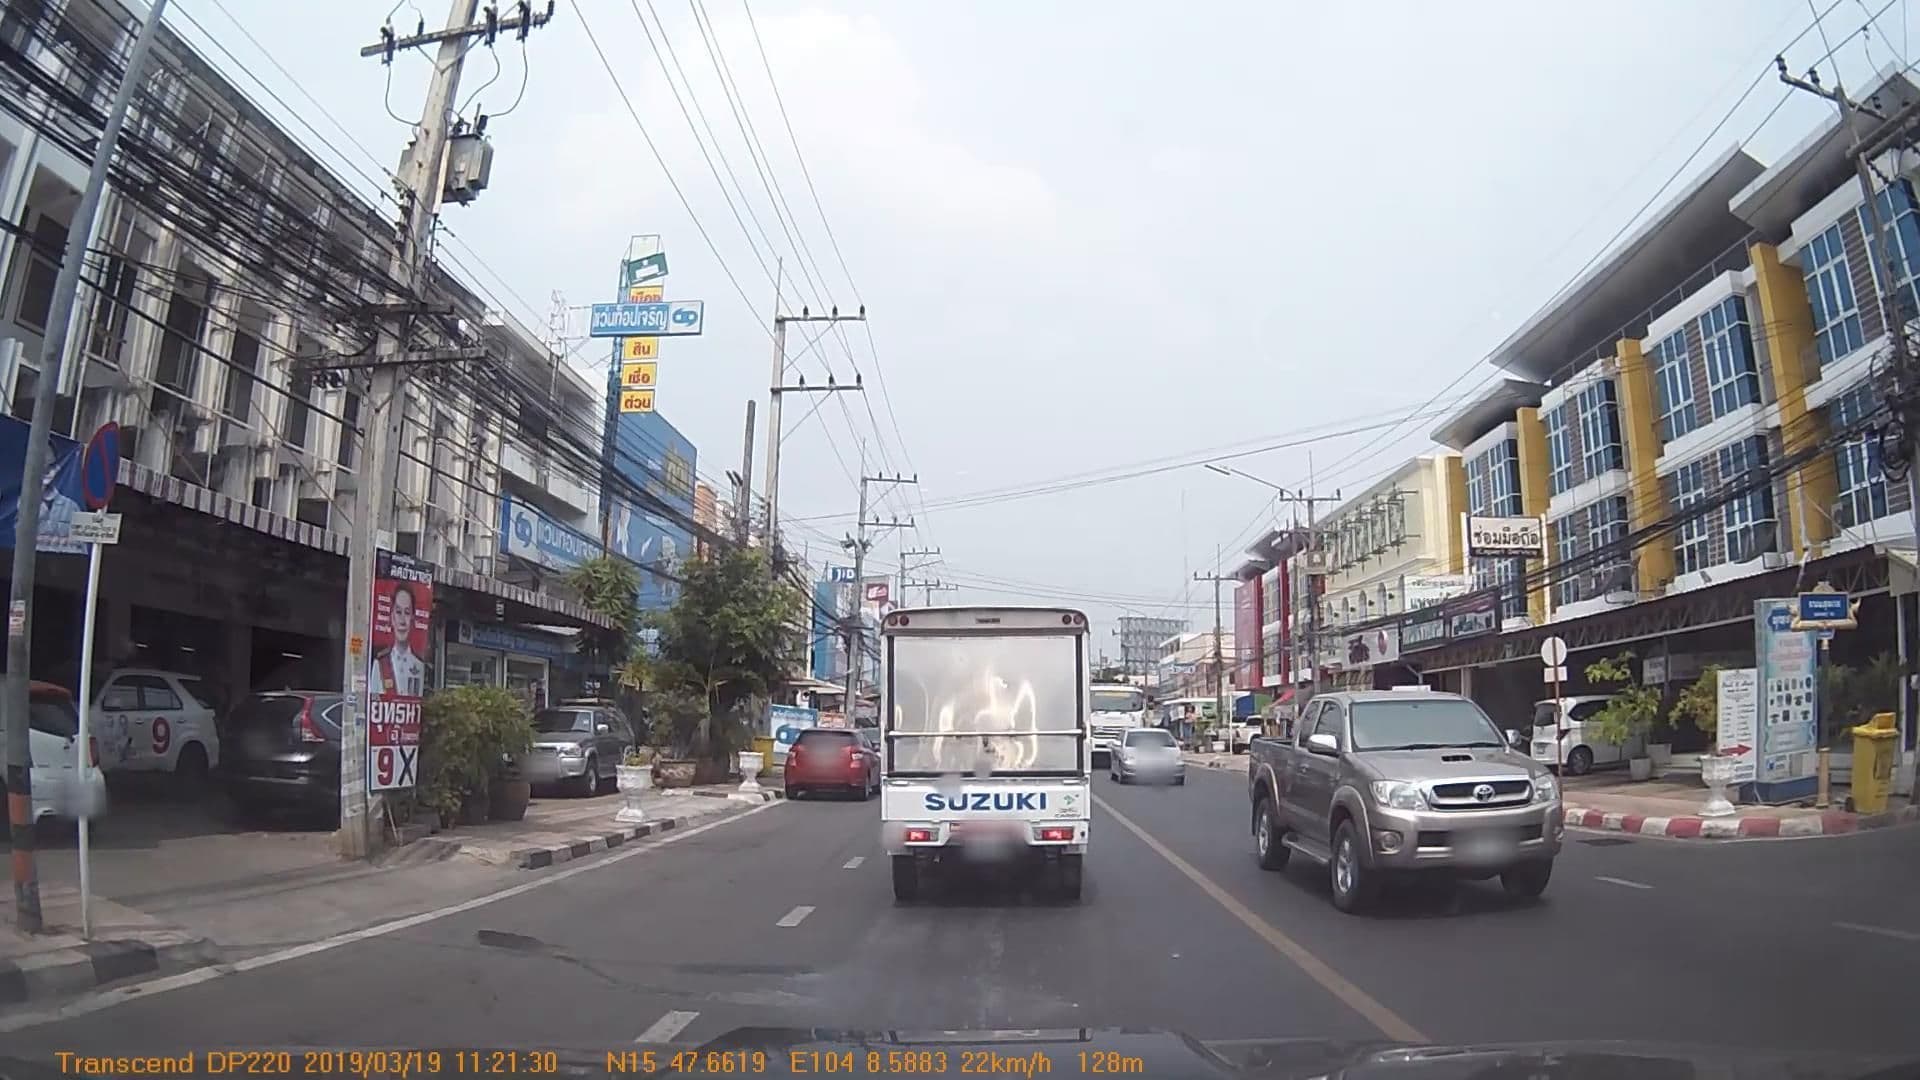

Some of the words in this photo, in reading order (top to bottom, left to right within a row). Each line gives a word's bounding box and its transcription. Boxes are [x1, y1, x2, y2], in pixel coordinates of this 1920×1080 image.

[1474, 525, 1538, 545] ซ่อมมือถือ
[152, 716, 170, 754] 9
[378, 748, 394, 786] 9
[925, 792, 1047, 811] SUZUKI
